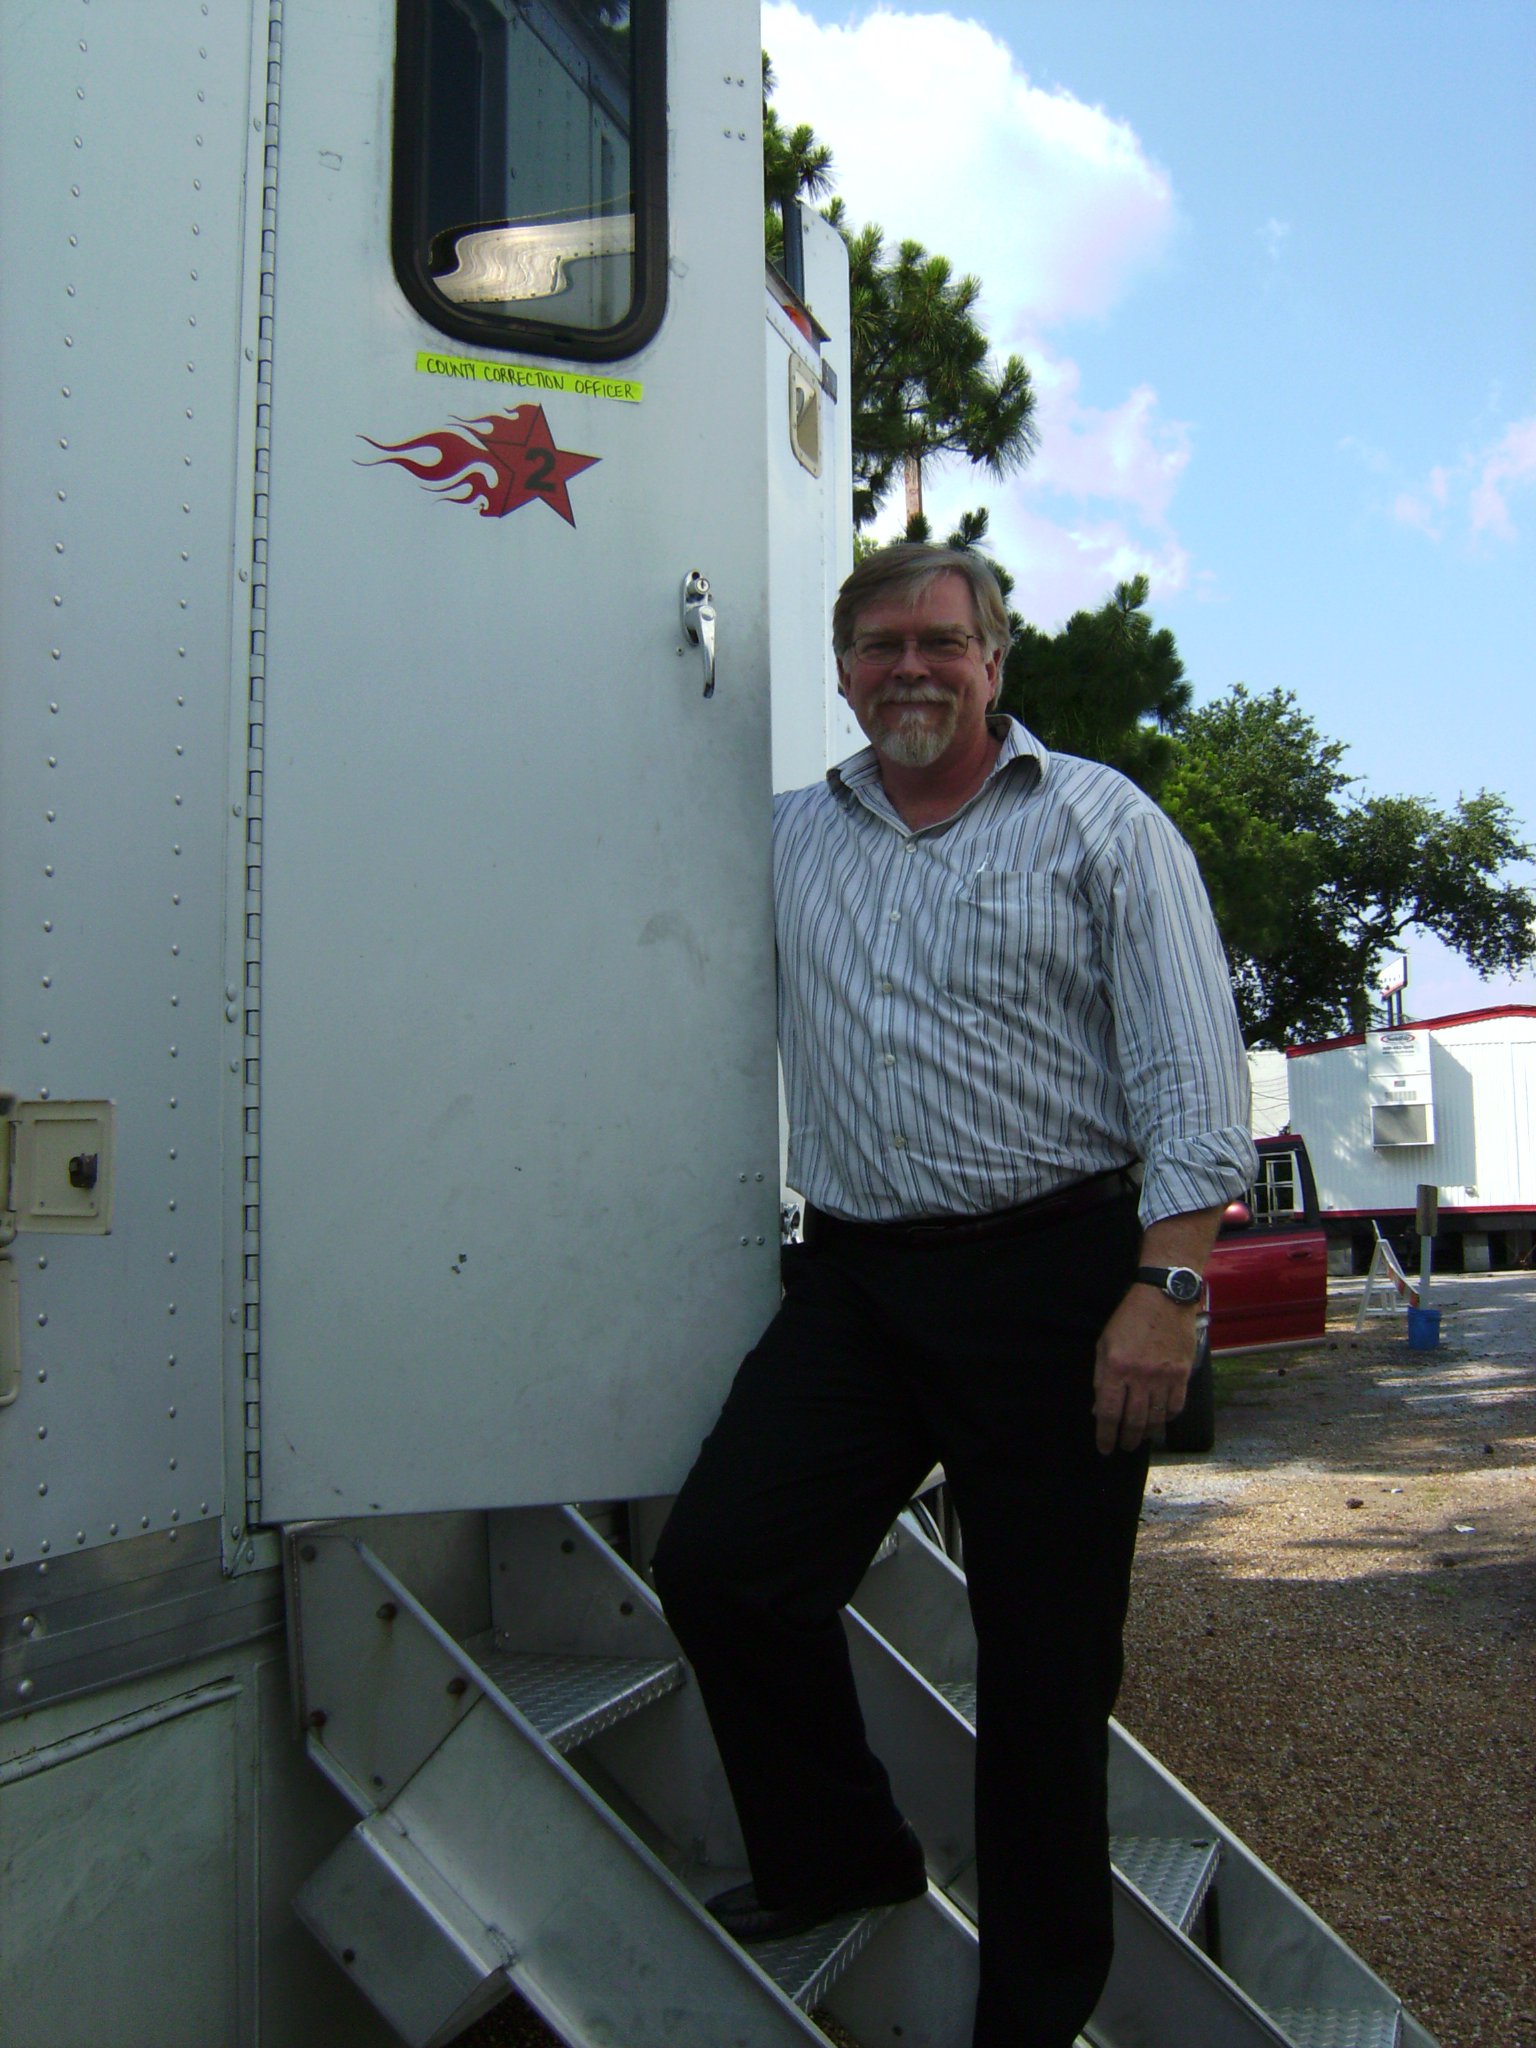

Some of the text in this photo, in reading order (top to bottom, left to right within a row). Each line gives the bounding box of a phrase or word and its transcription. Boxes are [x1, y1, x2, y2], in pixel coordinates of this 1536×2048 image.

[426, 358, 634, 399] COUNTY CORRECTION OFFICER
[523, 448, 555, 492] 2
